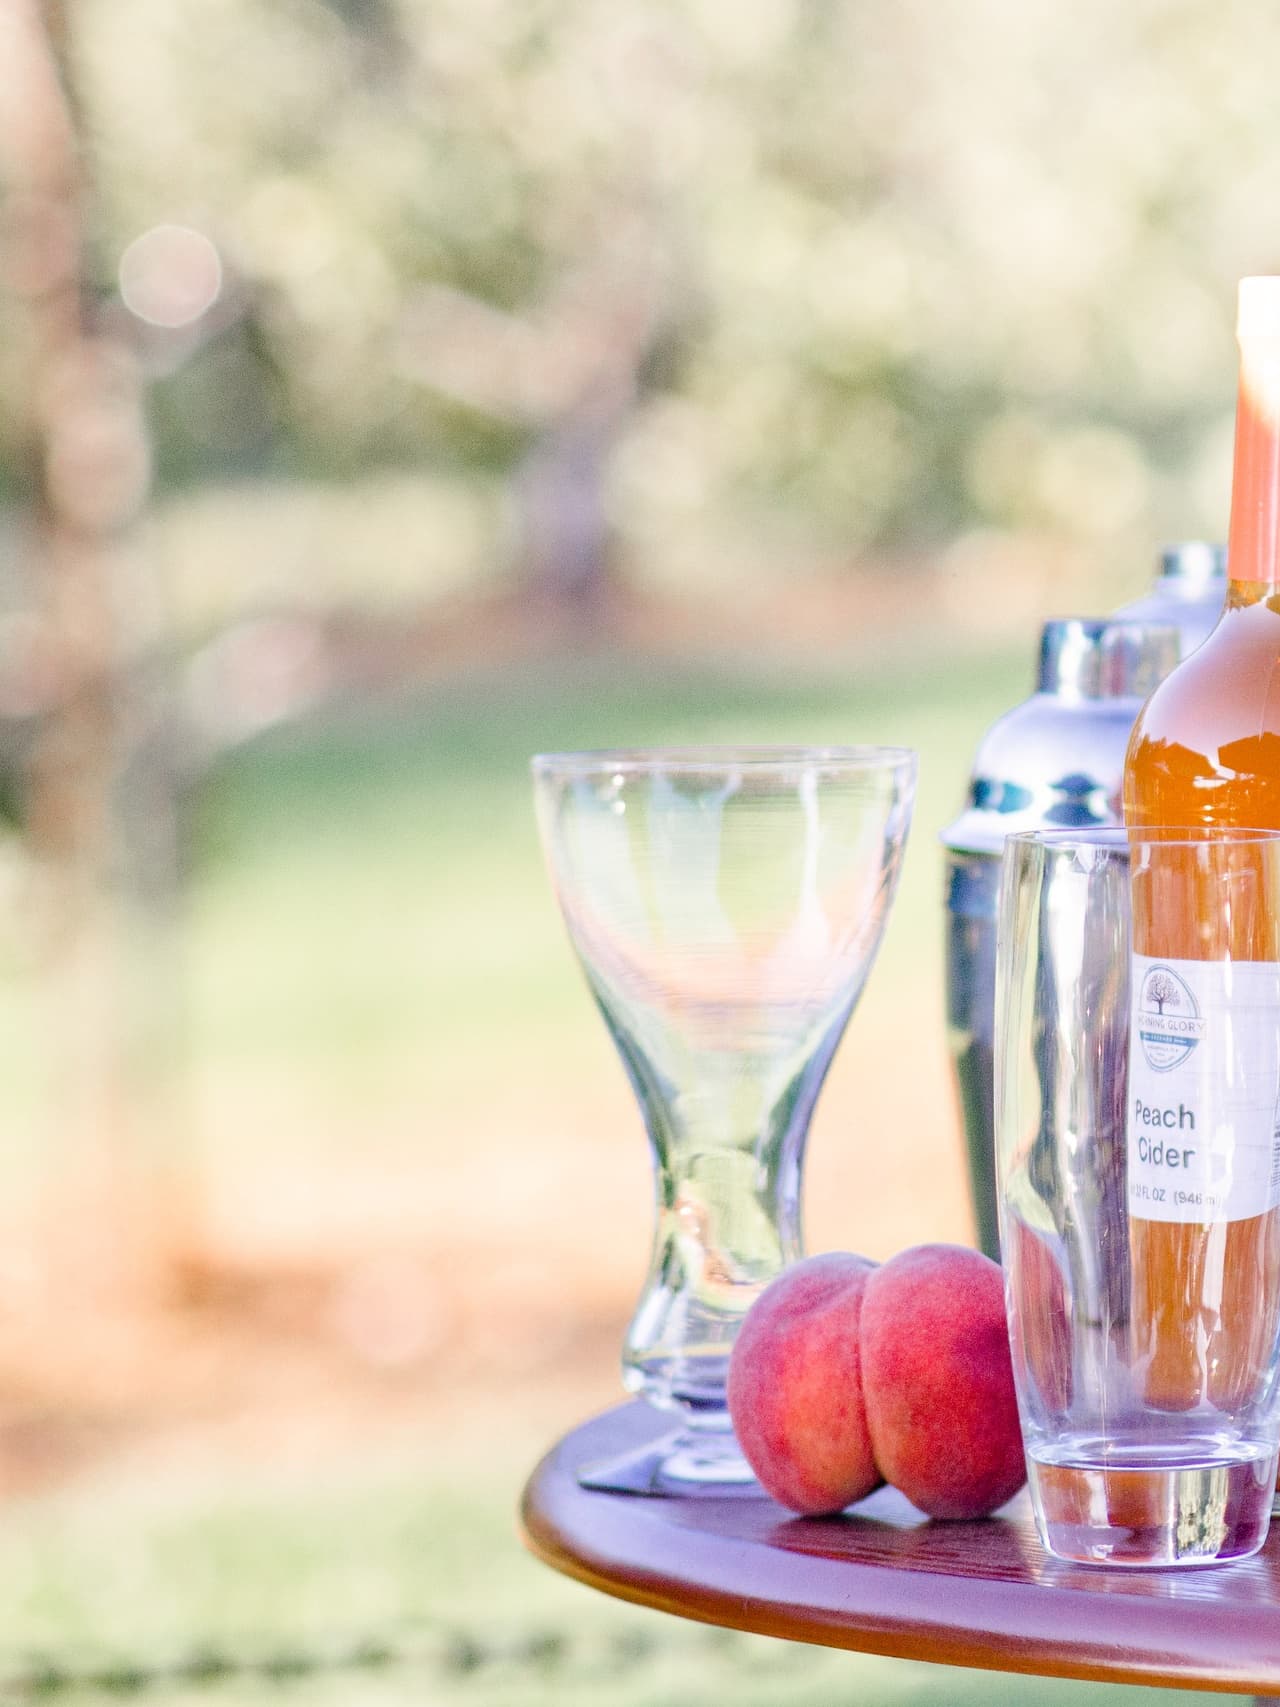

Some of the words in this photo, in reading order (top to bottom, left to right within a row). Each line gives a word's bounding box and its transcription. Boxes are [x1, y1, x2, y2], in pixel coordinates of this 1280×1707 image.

[1135, 1098, 1195, 1130] Peach
[1138, 1135, 1196, 1169] Cider
[1152, 1187, 1166, 1202] OZ
